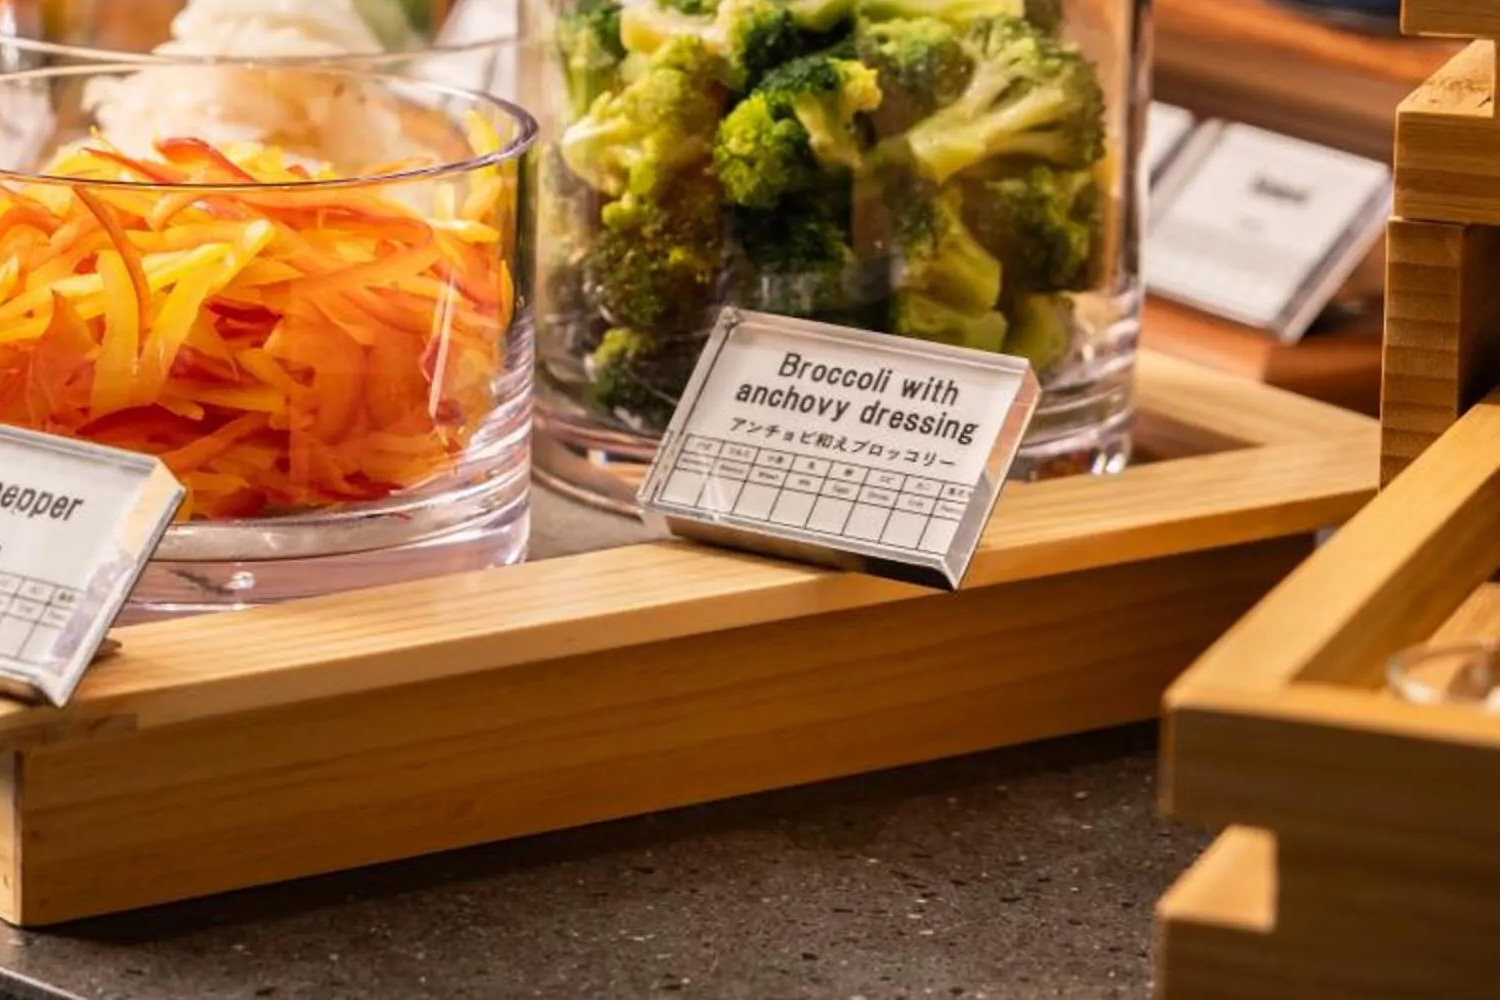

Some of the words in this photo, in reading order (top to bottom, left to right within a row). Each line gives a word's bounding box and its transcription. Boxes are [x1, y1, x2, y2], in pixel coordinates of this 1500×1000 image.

[778, 353, 893, 395] Broccoli
[902, 377, 960, 406] with
[735, 381, 851, 423] anchovy
[860, 399, 980, 445] dressing
